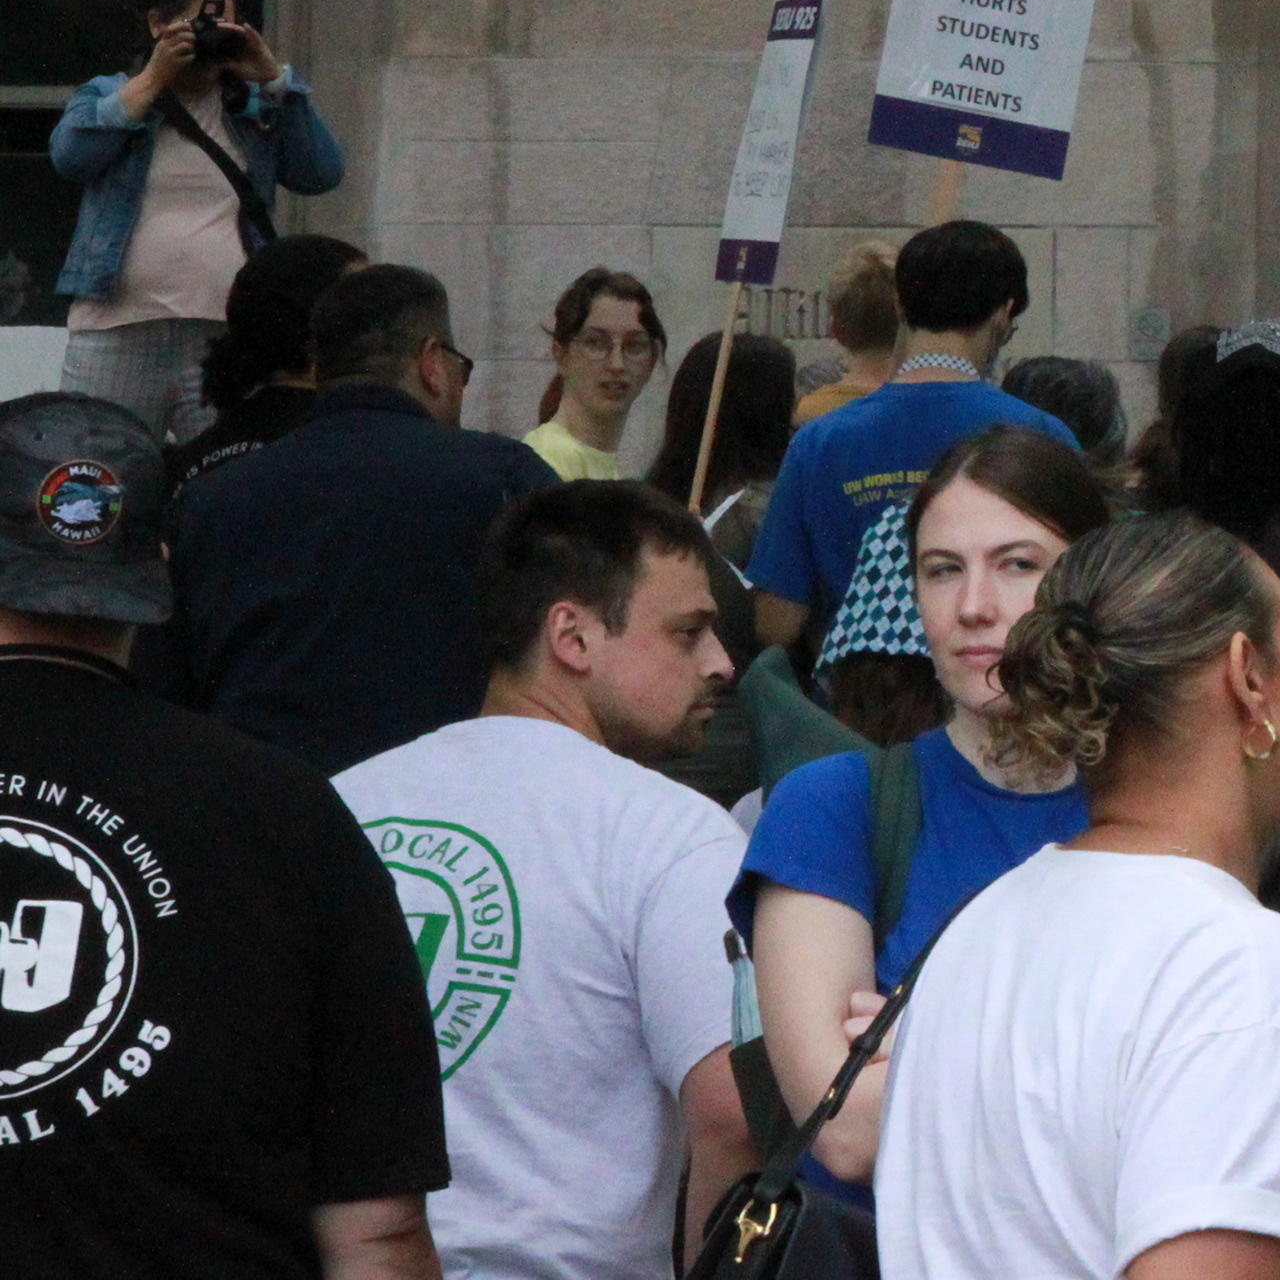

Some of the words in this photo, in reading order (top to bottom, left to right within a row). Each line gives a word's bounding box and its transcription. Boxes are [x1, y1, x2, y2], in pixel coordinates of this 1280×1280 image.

[795, 5, 818, 31] 925
[936, 16, 1040, 51] STUDENTS
[959, 53, 1005, 76] AND
[931, 80, 1022, 113] PATIENTS
[203, 441, 248, 467] POWER
[69, 465, 102, 480] MAUI
[37, 780, 67, 806] IN
[75, 795, 125, 837] THE
[122, 834, 178, 918] UNION
[380, 829, 469, 873] OCAL
[463, 866, 504, 951] 1495
[75, 1019, 172, 1117] 1495
